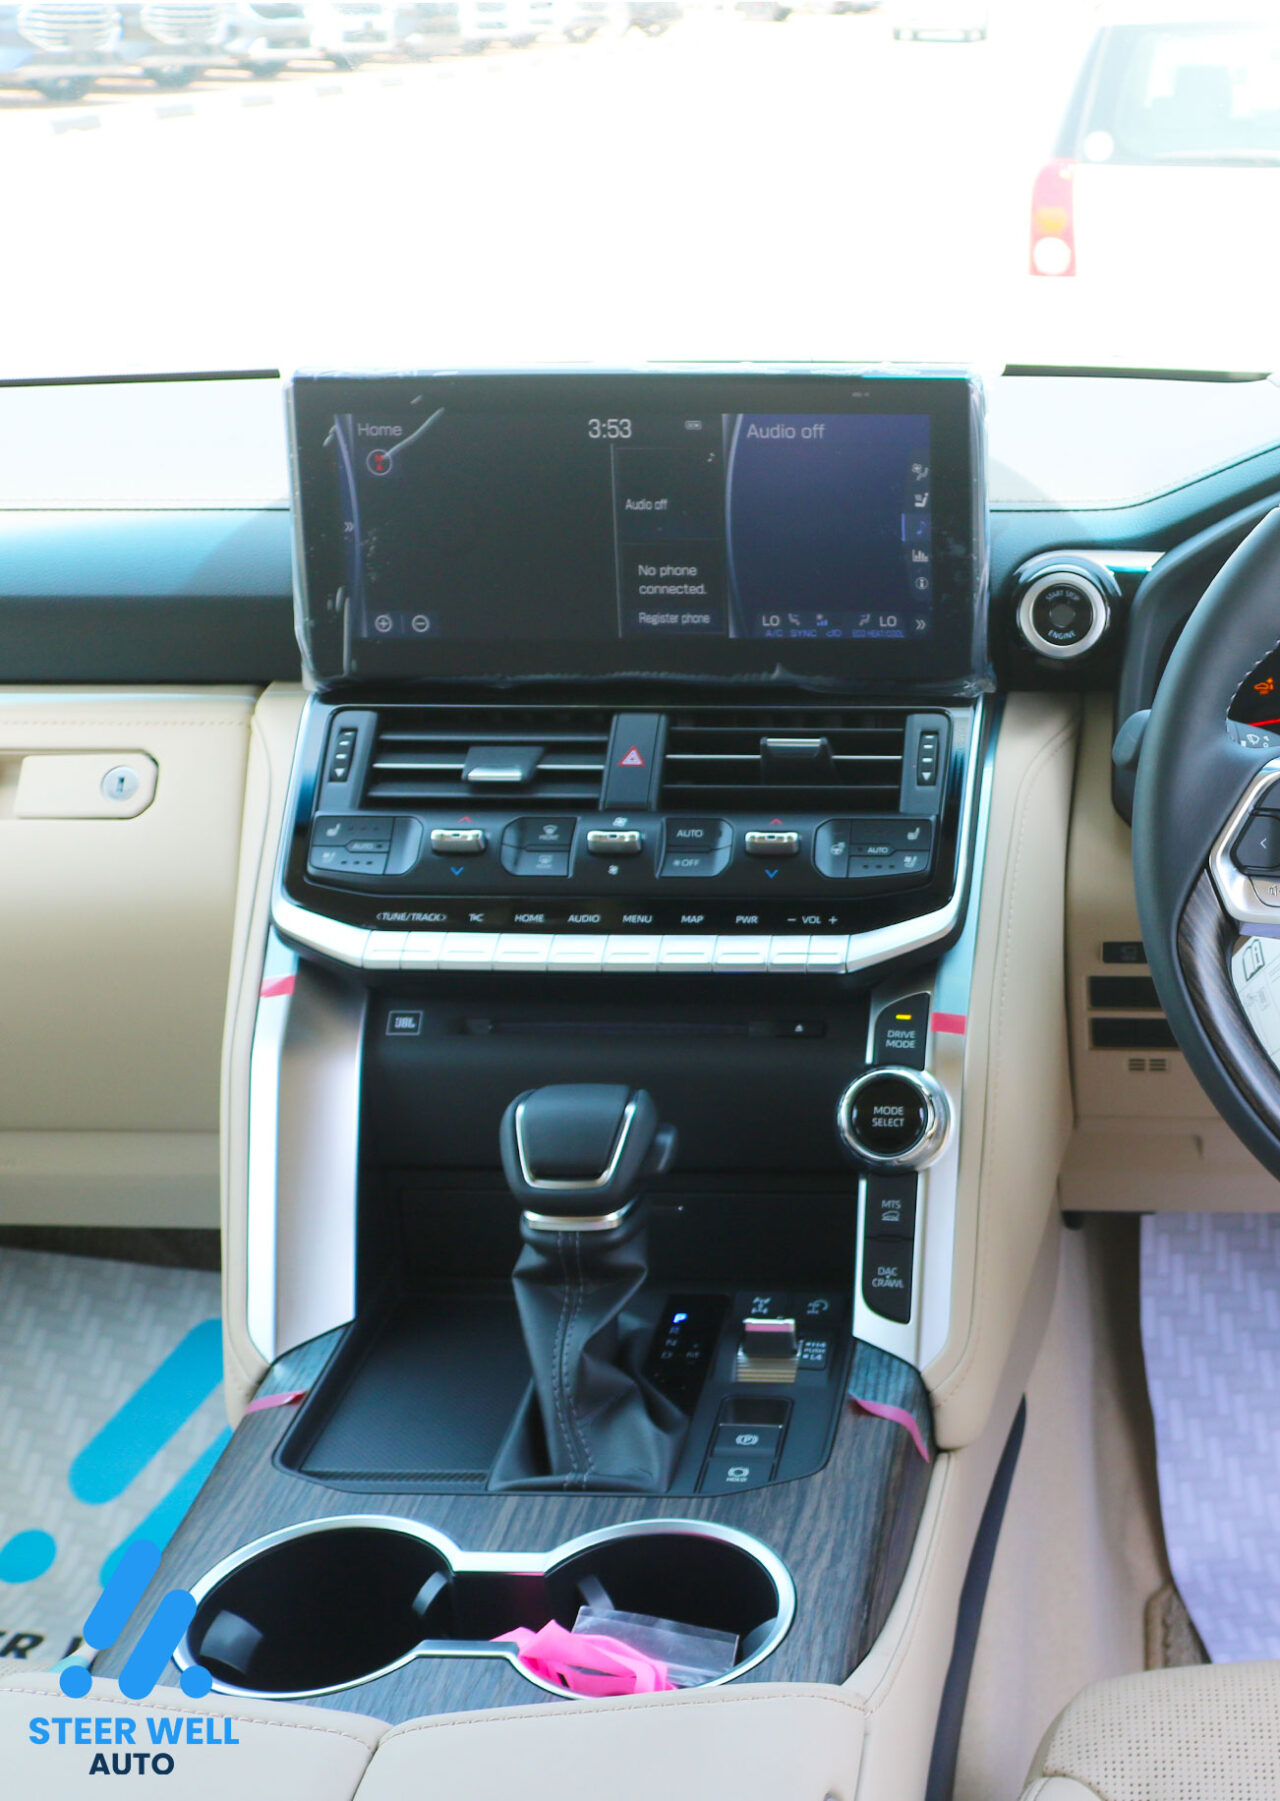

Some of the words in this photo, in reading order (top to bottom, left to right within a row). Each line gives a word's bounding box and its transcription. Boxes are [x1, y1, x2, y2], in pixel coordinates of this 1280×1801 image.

[357, 423, 403, 437] Home
[587, 418, 632, 439] 3:53
[746, 423, 797, 439] Audio
[800, 423, 825, 439] off
[625, 498, 653, 511] Audio
[654, 498, 668, 511] off
[637, 564, 656, 577] No
[659, 564, 698, 578] phone
[638, 583, 708, 595] connected.
[638, 611, 679, 626] Register
[681, 612, 712, 625] phone
[762, 615, 781, 627] LO
[879, 615, 898, 627] LO
[676, 828, 704, 839] AUTO
[867, 846, 889, 854] AUTO
[681, 858, 699, 867] OFF
[514, 913, 545, 923] HOME
[567, 913, 601, 924] AUDIO
[622, 914, 653, 924] MENU
[680, 914, 704, 924] MAP
[735, 914, 759, 924] PWR
[801, 915, 822, 925] VOL
[886, 1029, 916, 1039] DRIVE
[885, 1039, 916, 1049] MODE
[873, 1105, 905, 1116] MODE
[871, 1117, 905, 1128] SELECT
[881, 1199, 902, 1210] MTS
[877, 1265, 898, 1277] DAC
[871, 1277, 904, 1289] CRAWL
[672, 1312, 688, 1324] P
